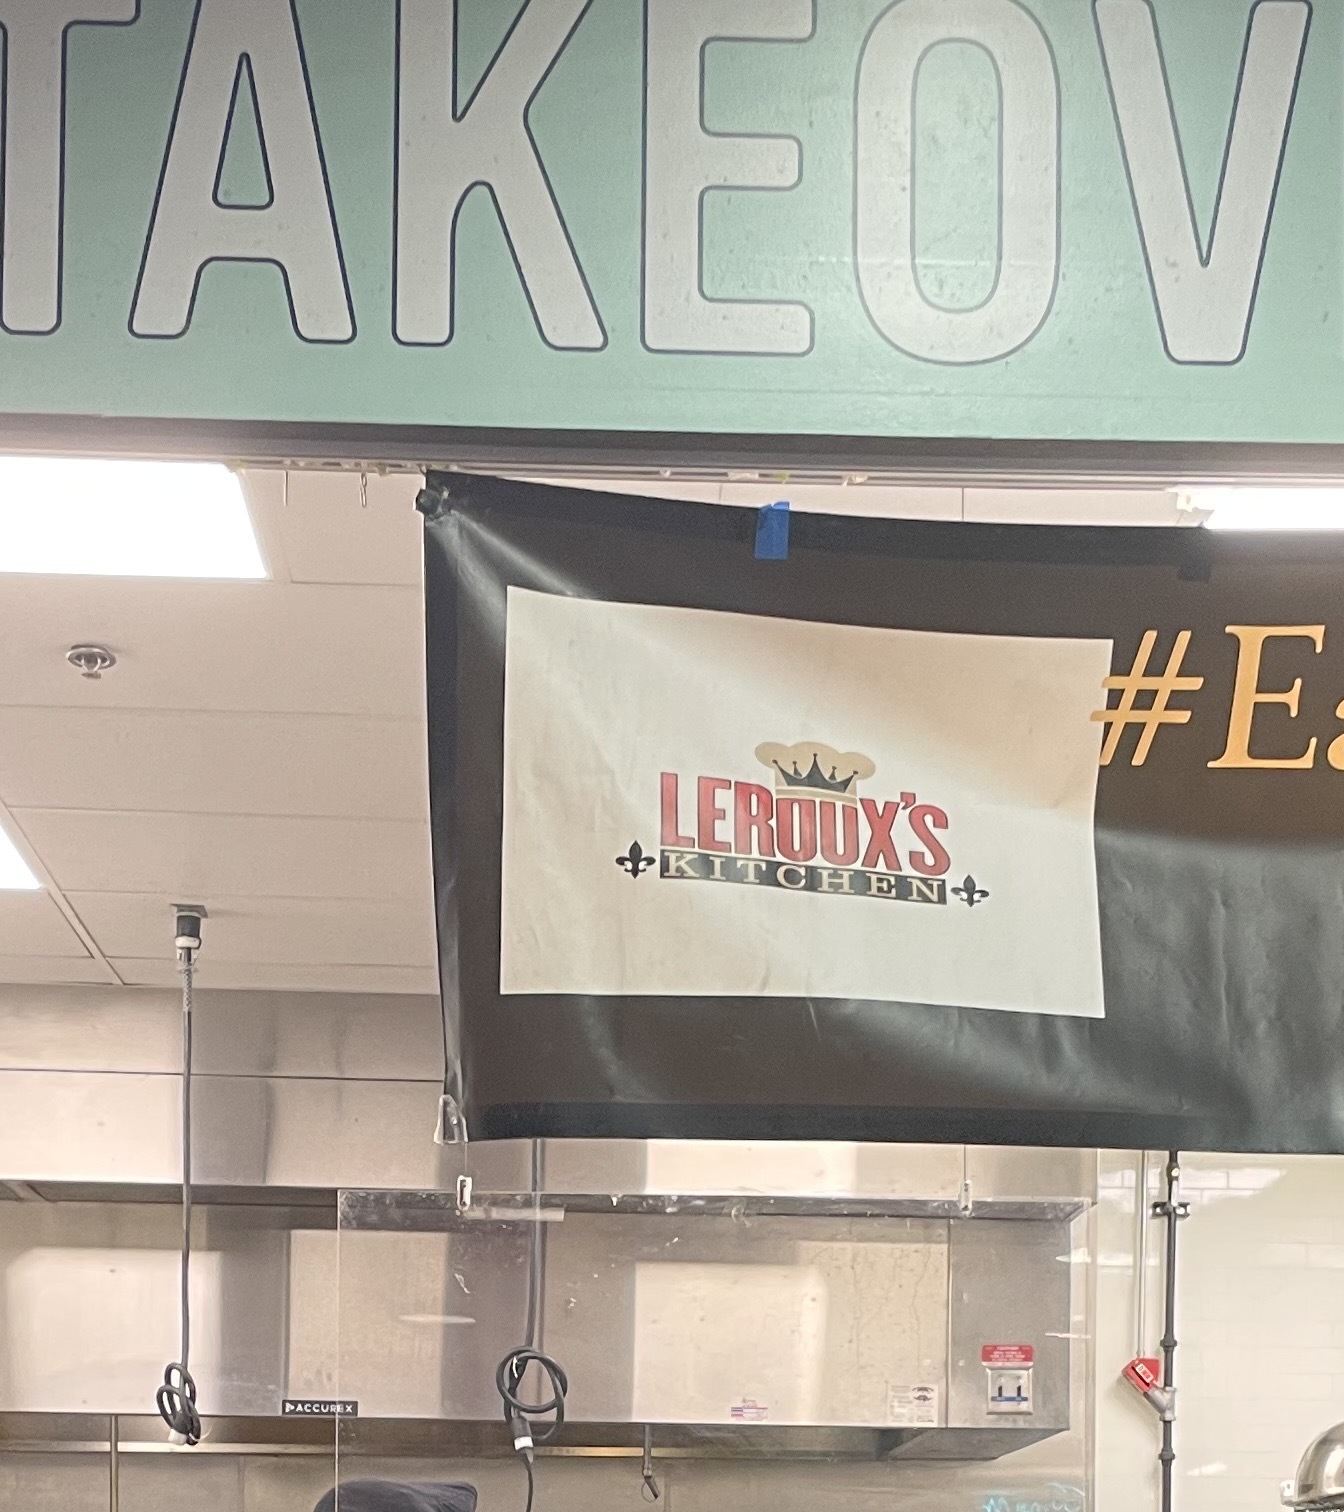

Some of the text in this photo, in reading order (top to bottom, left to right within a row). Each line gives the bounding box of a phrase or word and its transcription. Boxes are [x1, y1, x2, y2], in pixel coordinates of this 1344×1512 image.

[660, 771, 951, 877] LEROUX'S
[663, 851, 944, 903] KITCHEN
[295, 1402, 353, 1414] ACCUREX
